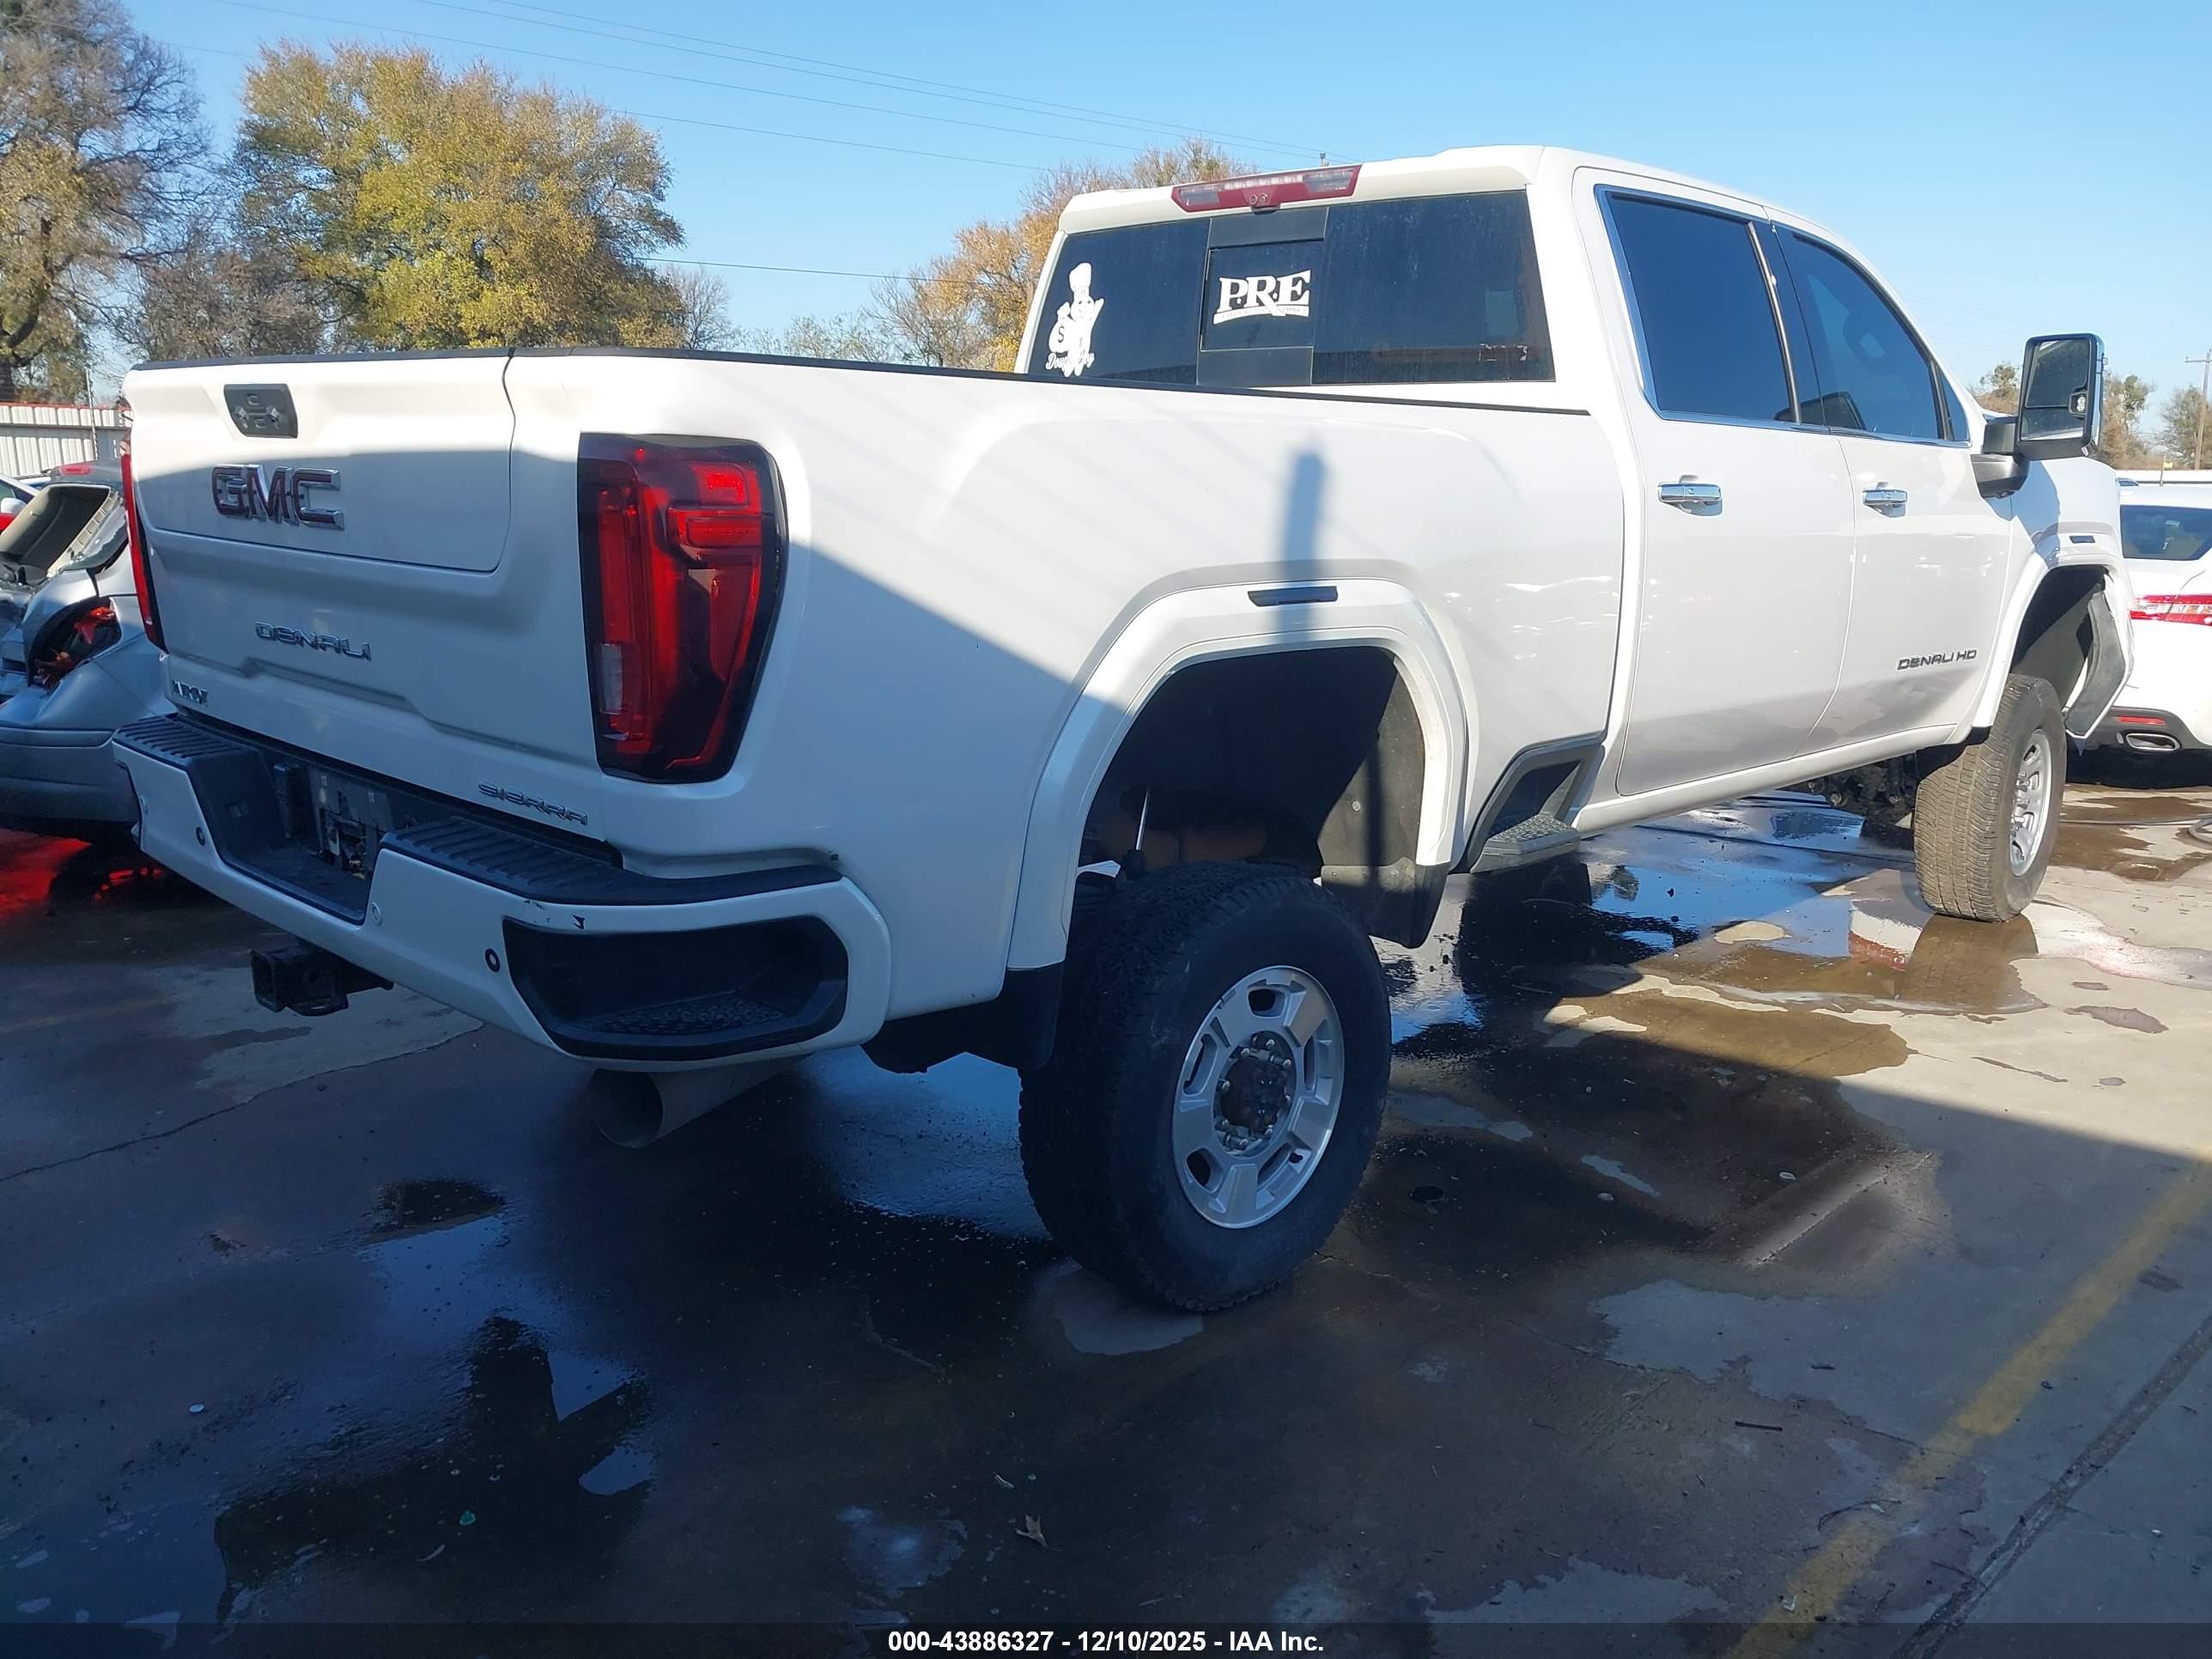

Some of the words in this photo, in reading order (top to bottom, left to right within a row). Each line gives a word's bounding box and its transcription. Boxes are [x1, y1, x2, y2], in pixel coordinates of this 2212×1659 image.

[212, 464, 345, 531] GMC
[255, 621, 372, 661] DENALI
[1897, 652, 1954, 670] DENALI
[1956, 649, 1978, 661] HD
[477, 782, 588, 825] SIERRA
